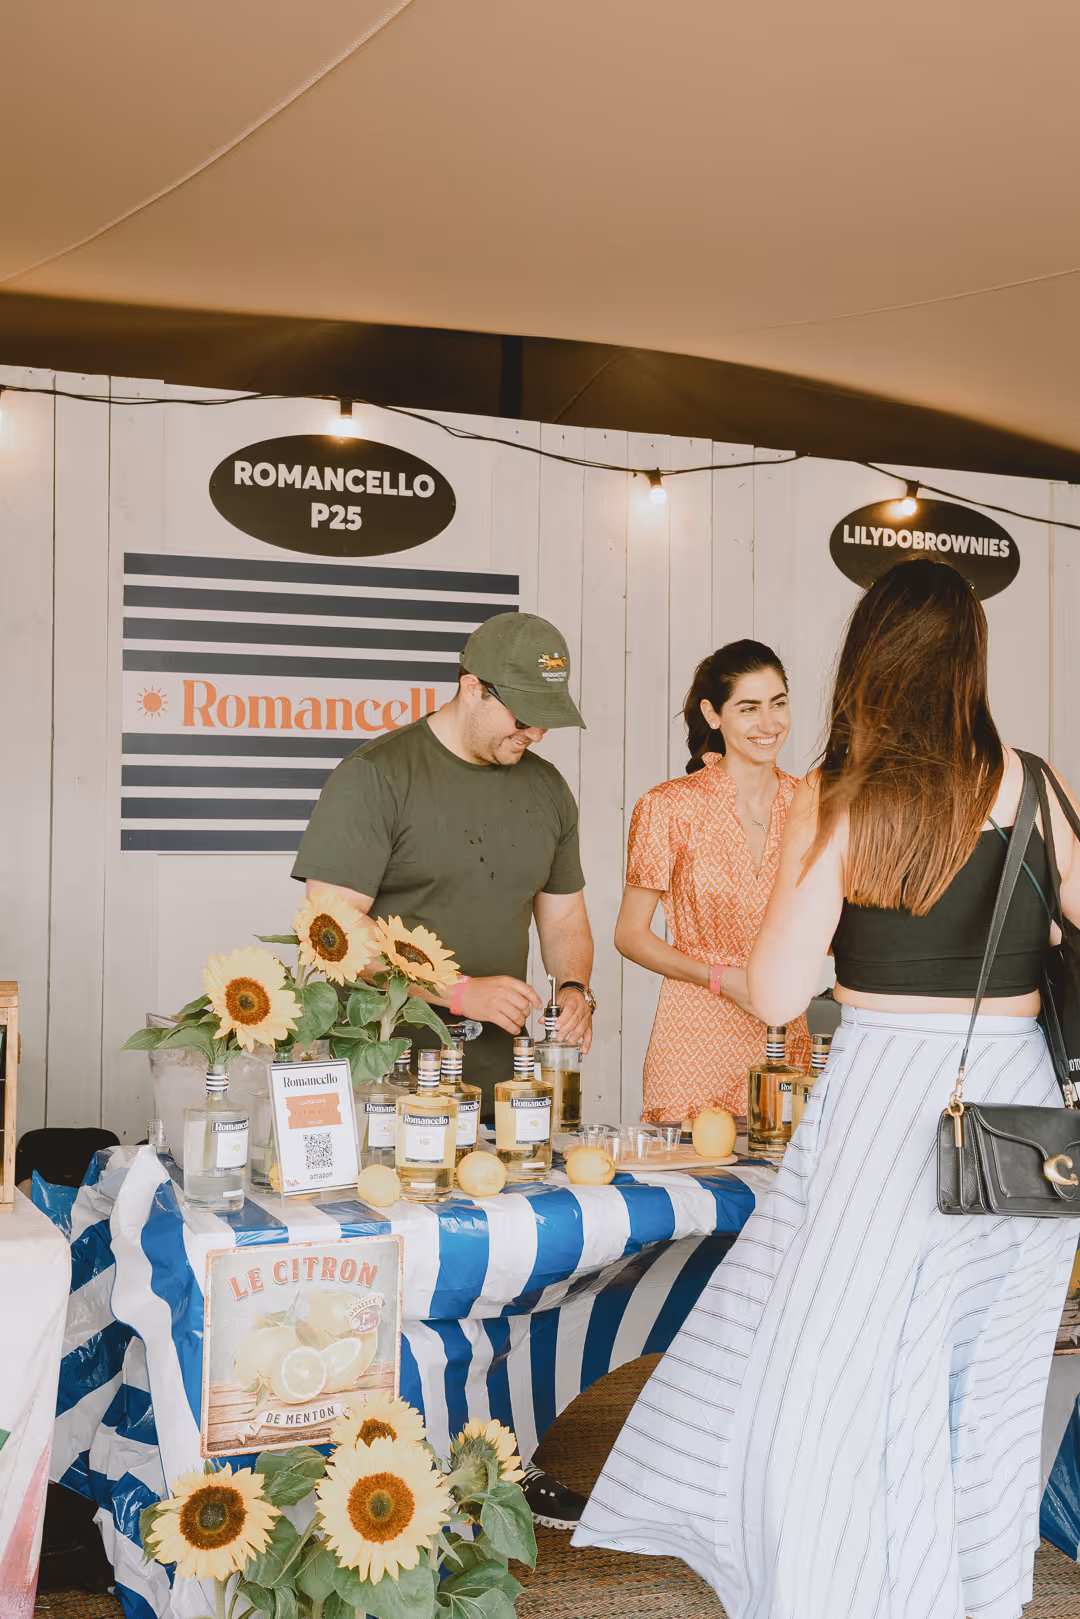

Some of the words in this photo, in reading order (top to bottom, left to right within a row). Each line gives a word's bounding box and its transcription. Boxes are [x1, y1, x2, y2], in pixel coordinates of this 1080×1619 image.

[234, 460, 436, 498] ROMANCELLO
[311, 502, 363, 531] P25
[843, 525, 1010, 557] LILYDOBROWNIES
[181, 679, 447, 732] Romancell
[283, 1073, 338, 1088] Romancello
[404, 1114, 449, 1125] Romancello
[228, 1267, 264, 1300] LE
[273, 1256, 378, 1288] CITRON
[266, 1412, 281, 1424] DE
[285, 1405, 335, 1425] MENTON
